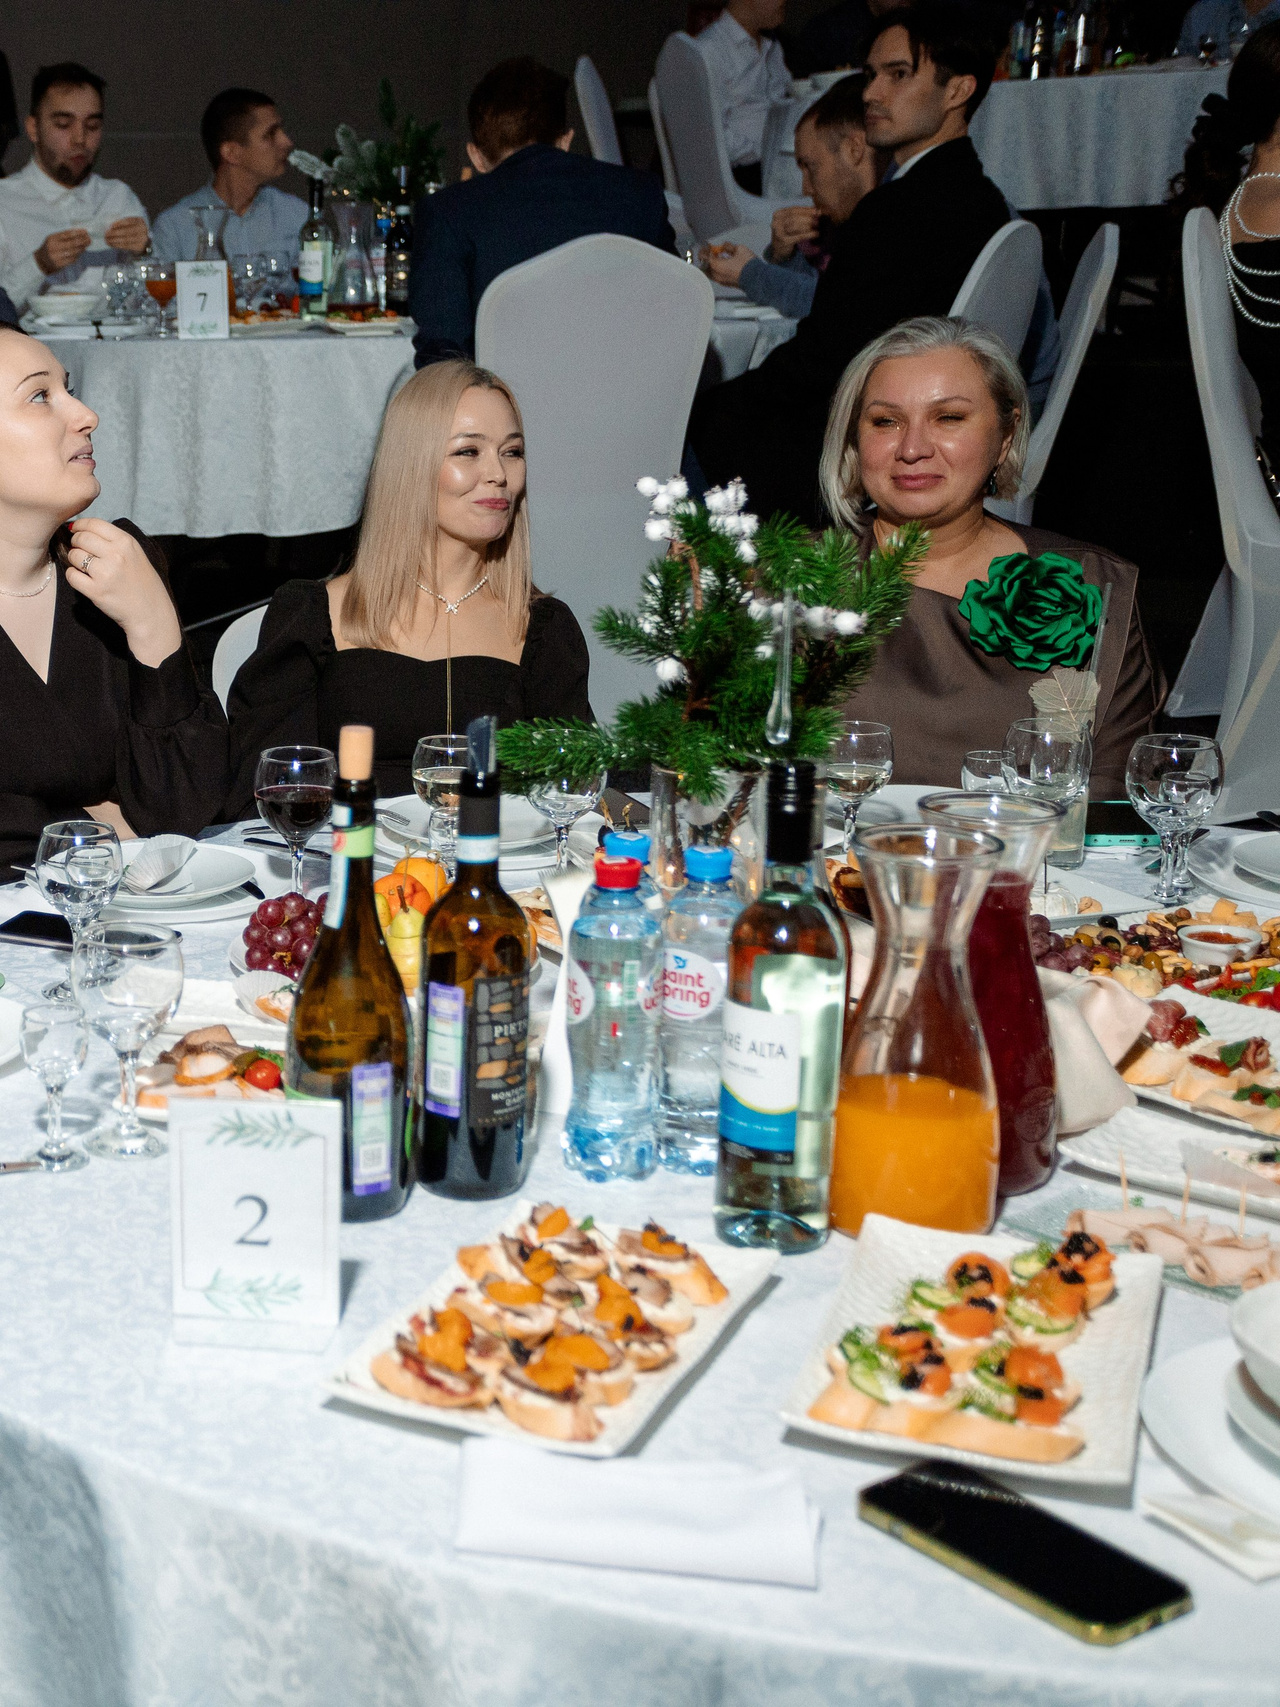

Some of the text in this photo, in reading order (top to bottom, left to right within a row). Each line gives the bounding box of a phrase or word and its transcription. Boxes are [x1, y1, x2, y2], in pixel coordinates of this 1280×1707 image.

[196, 292, 207, 312] 7
[748, 1040, 787, 1059] ALTA
[235, 1194, 271, 1246] 2
